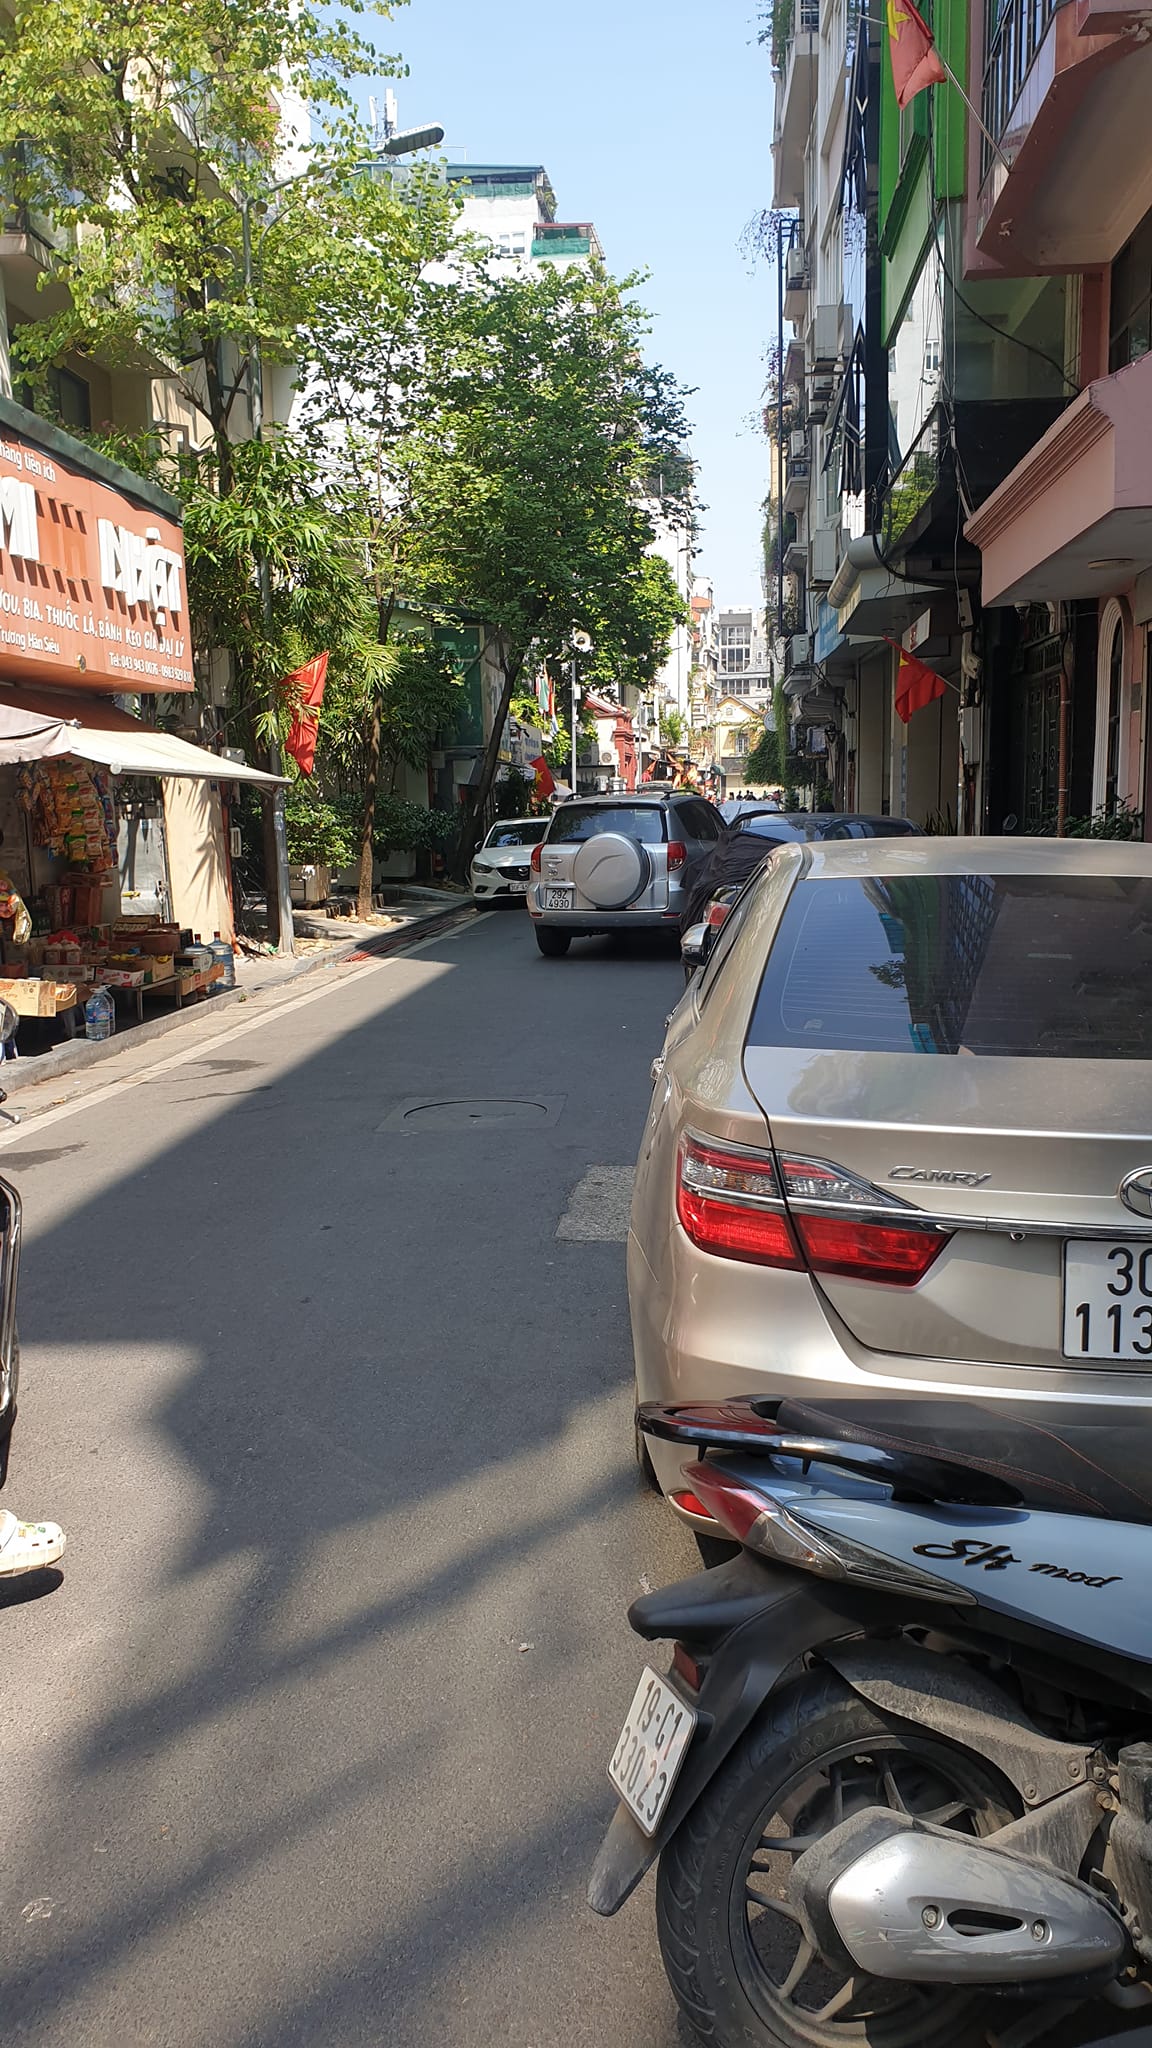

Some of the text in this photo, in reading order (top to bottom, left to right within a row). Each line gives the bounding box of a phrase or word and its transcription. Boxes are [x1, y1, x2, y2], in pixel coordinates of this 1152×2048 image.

[24, 451, 42, 477] tiện
[45, 599, 80, 632] THUỐC
[98, 616, 122, 643] BÁNH
[125, 627, 142, 649] KẸO
[159, 636, 174, 659] ĐẠI
[175, 635, 185, 658] LÝ
[43, 636, 60, 655] Siêu
[549, 899, 570, 909] 4930
[552, 889, 568, 900] 29Z
[1075, 1302, 1152, 1354] 113
